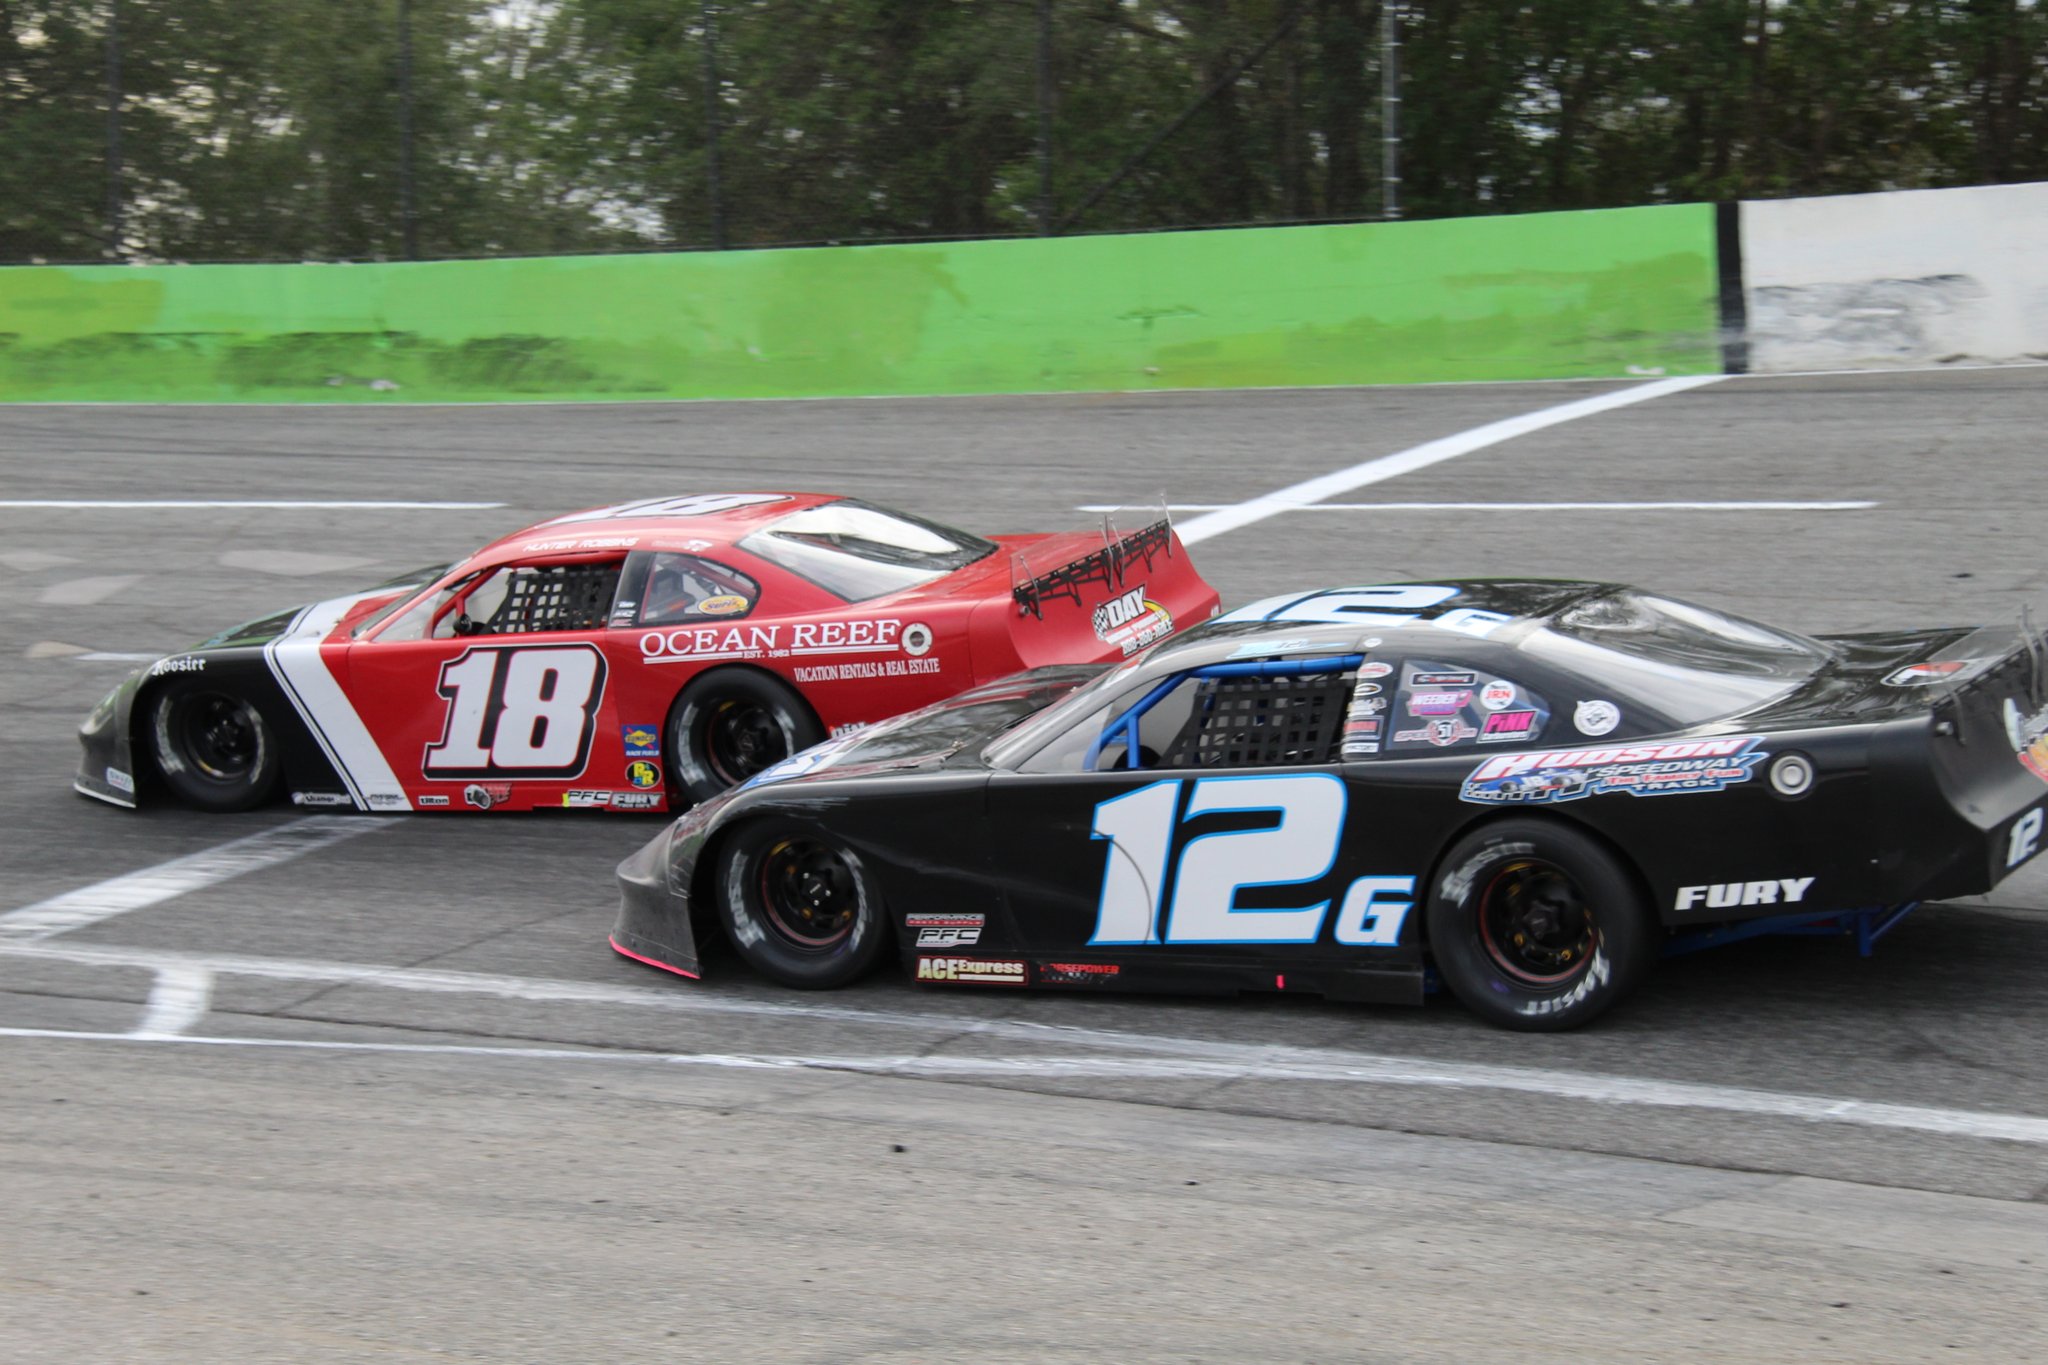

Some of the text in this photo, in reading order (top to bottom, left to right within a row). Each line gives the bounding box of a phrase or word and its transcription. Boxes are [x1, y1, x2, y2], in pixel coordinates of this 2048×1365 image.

[523, 540, 576, 551] HUNTER
[578, 537, 639, 548] ROBBINS
[1105, 585, 1147, 629] DAY
[1203, 585, 1460, 627] 12
[640, 619, 901, 656] OCEAN REEF
[151, 656, 206, 676] Hoosier
[744, 649, 790, 659] EST. 1982
[794, 658, 940, 682] VACATION RENTALS & REAL ESTATE
[422, 641, 609, 781] 18
[1473, 739, 1748, 781] HUDSON
[1597, 757, 1750, 777] SPEEDWAY
[1631, 779, 1717, 791] TRACK
[568, 791, 664, 805] PFC FURY
[2006, 807, 2043, 867] 12
[1086, 773, 1348, 945] 12
[1334, 875, 1417, 945] G
[1674, 877, 1816, 910] FURY
[920, 929, 980, 940] PFC
[918, 958, 1024, 979] ACE Express
